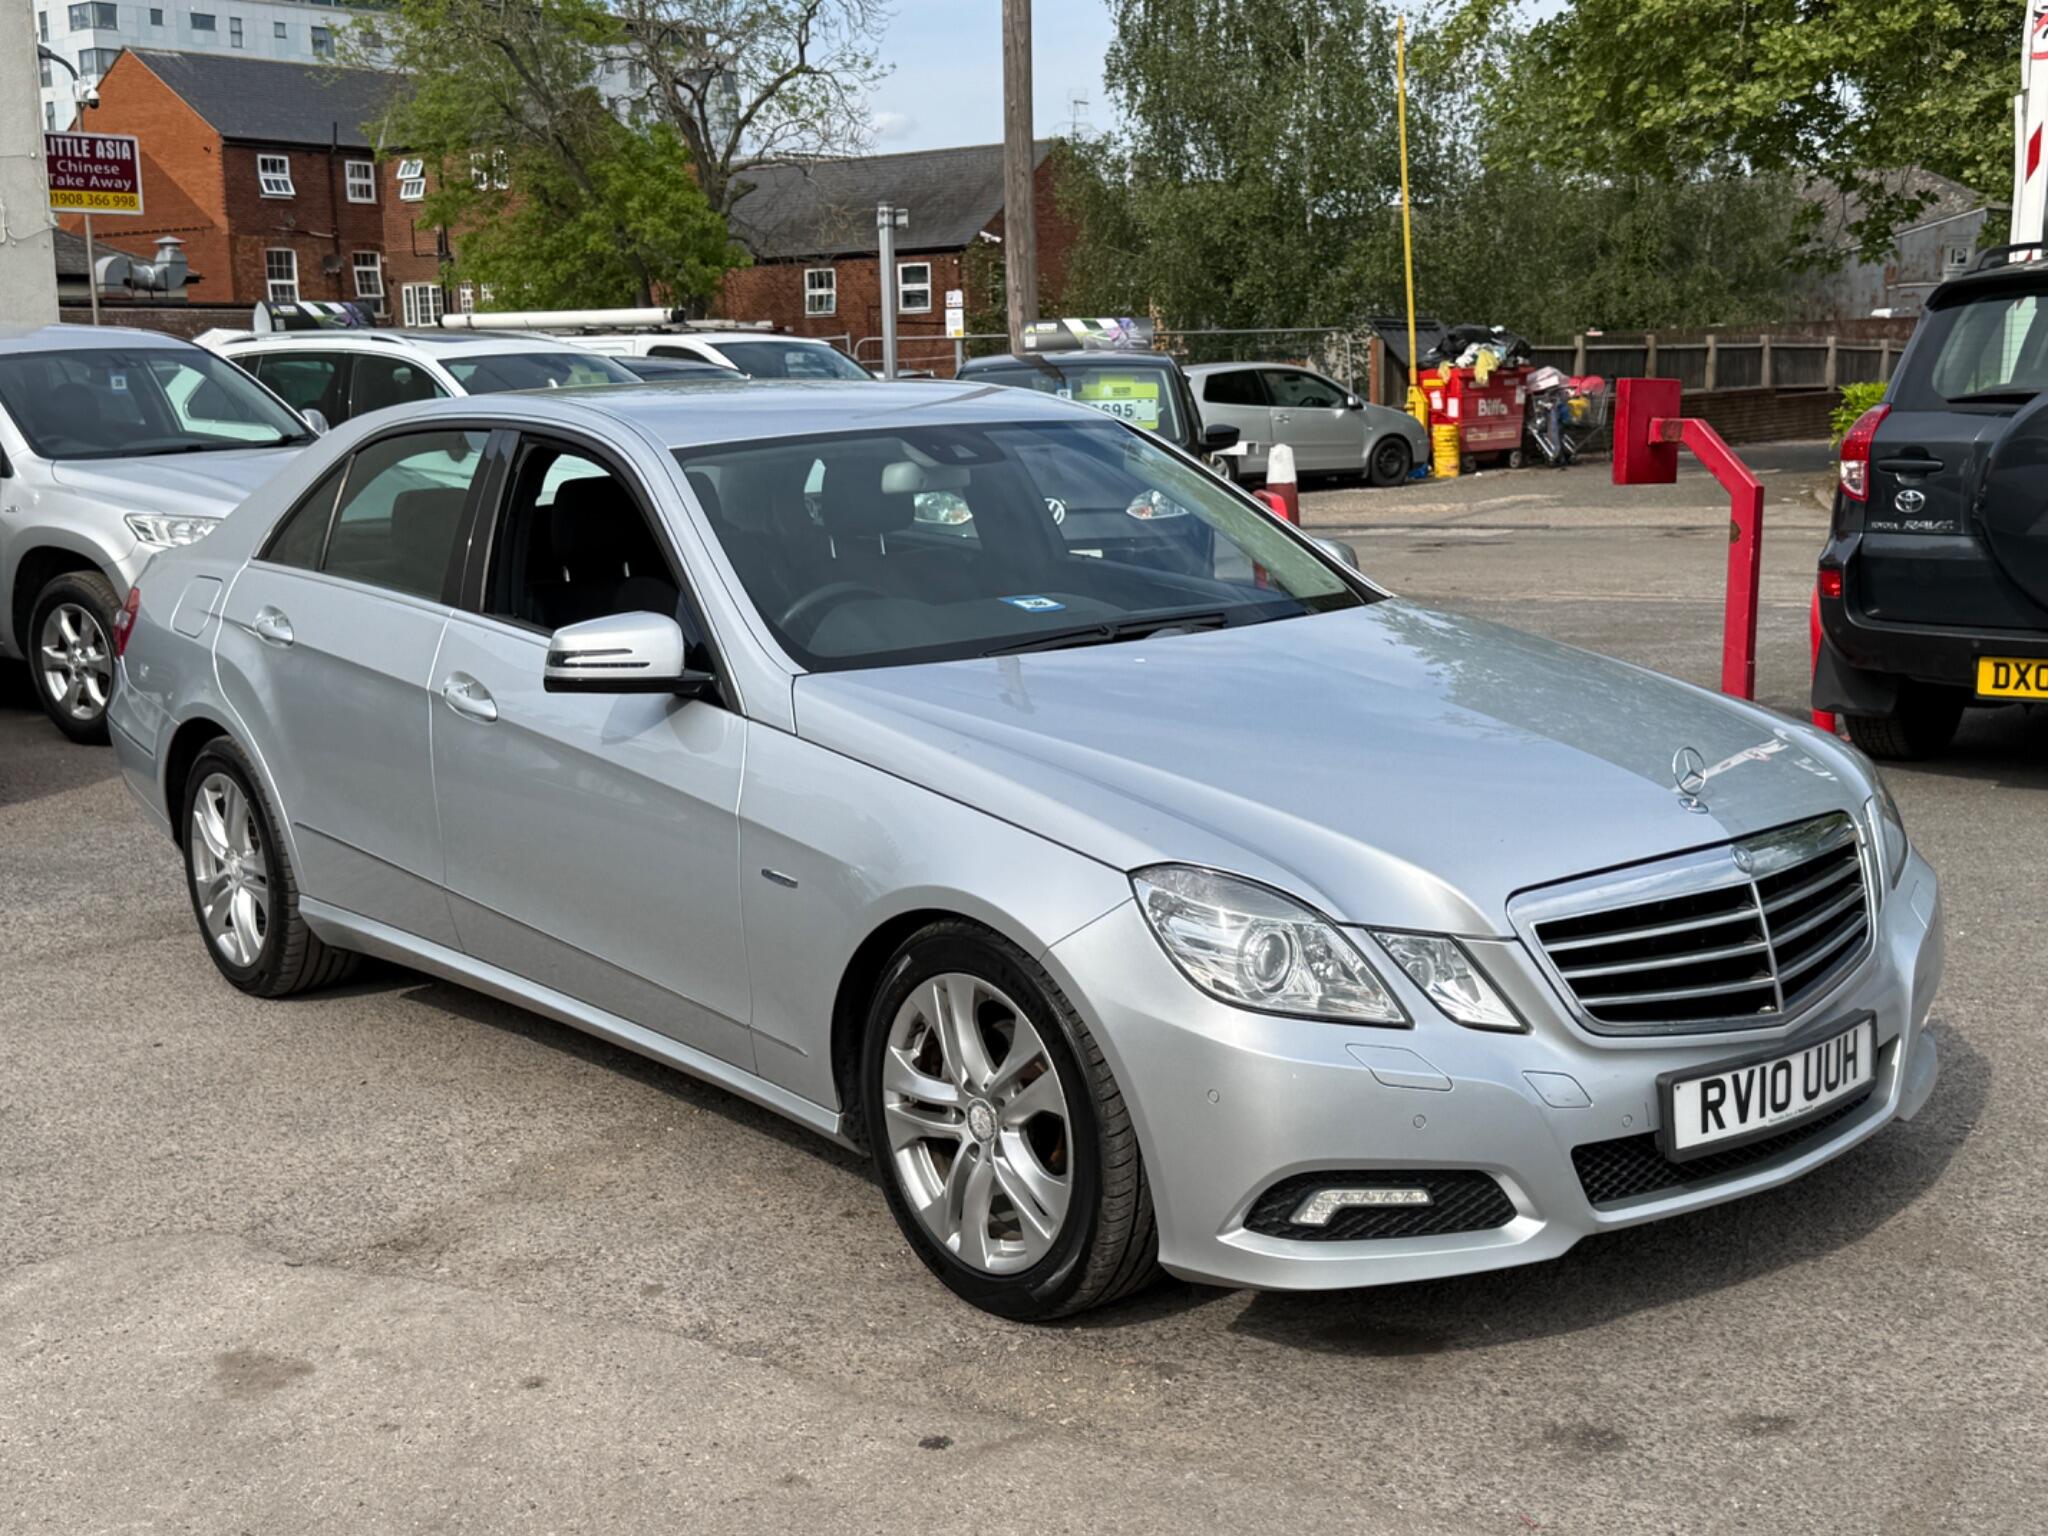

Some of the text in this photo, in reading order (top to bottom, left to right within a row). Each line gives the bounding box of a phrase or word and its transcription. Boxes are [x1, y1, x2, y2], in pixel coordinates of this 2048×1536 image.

[95, 140, 131, 160] ASIA
[56, 160, 120, 175] Chinese
[48, 173, 132, 192] Take Away
[87, 194, 110, 206] 366
[112, 195, 136, 208] 998
[1478, 398, 1508, 416] Biffa
[1700, 1029, 1858, 1134] RV10 UUH
